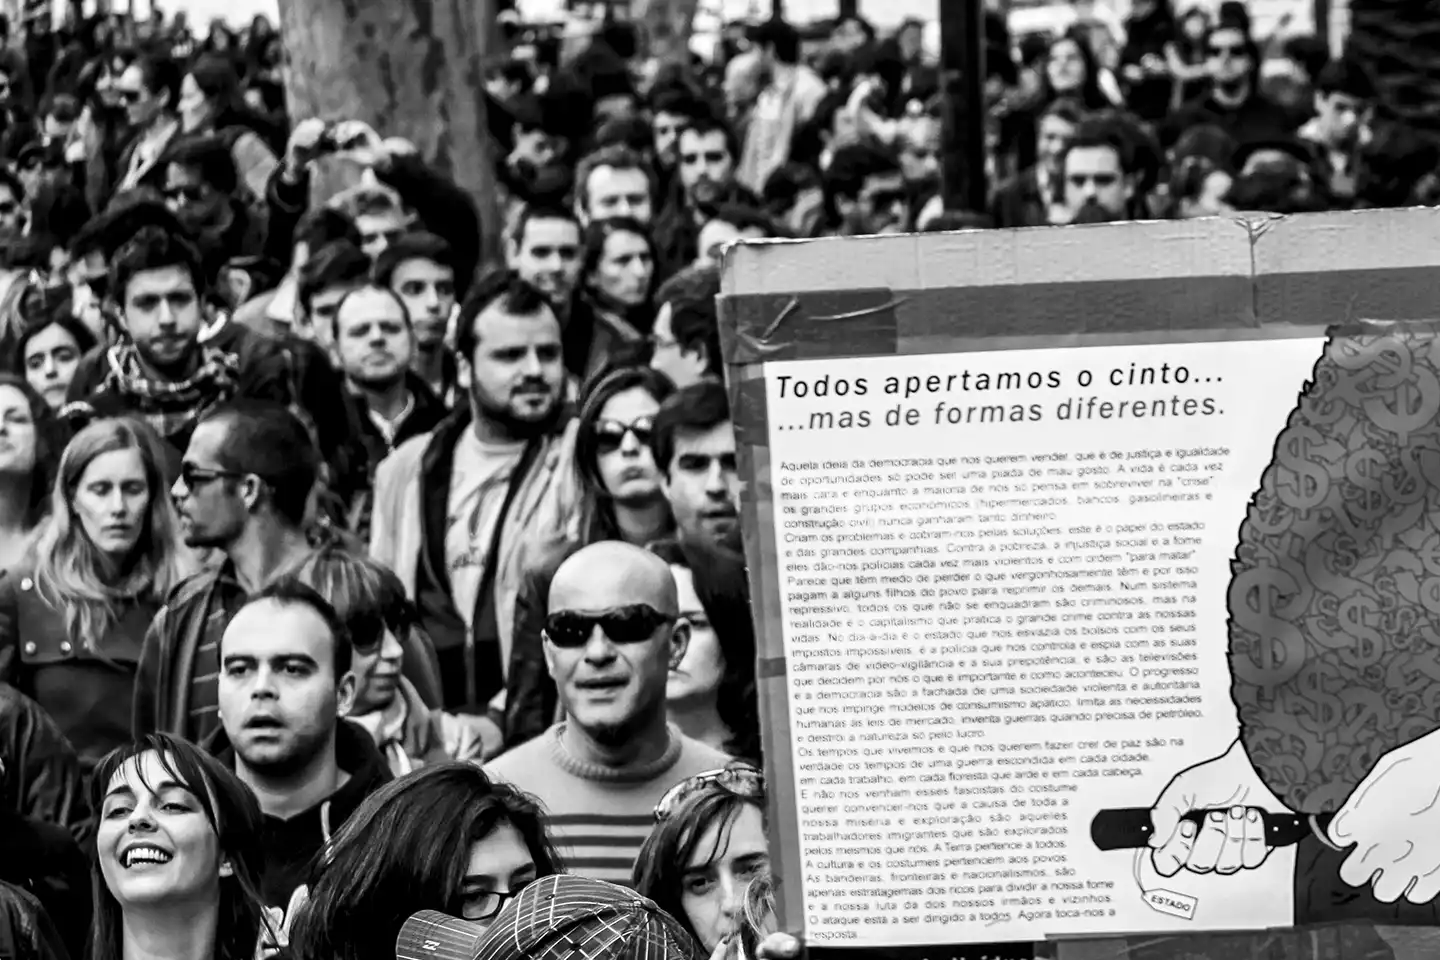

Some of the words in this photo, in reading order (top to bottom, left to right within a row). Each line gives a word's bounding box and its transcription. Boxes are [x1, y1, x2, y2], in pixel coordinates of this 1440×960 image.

[776, 374, 868, 399] Todos
[883, 369, 1061, 398] apertamos
[1077, 369, 1093, 388] o
[1109, 362, 1222, 386] cinto...
[779, 410, 871, 431] ...mas
[885, 404, 920, 427] de
[935, 401, 1042, 425] formas
[1056, 395, 1224, 421] diferentes.
[1151, 894, 1191, 911] ESTADO
